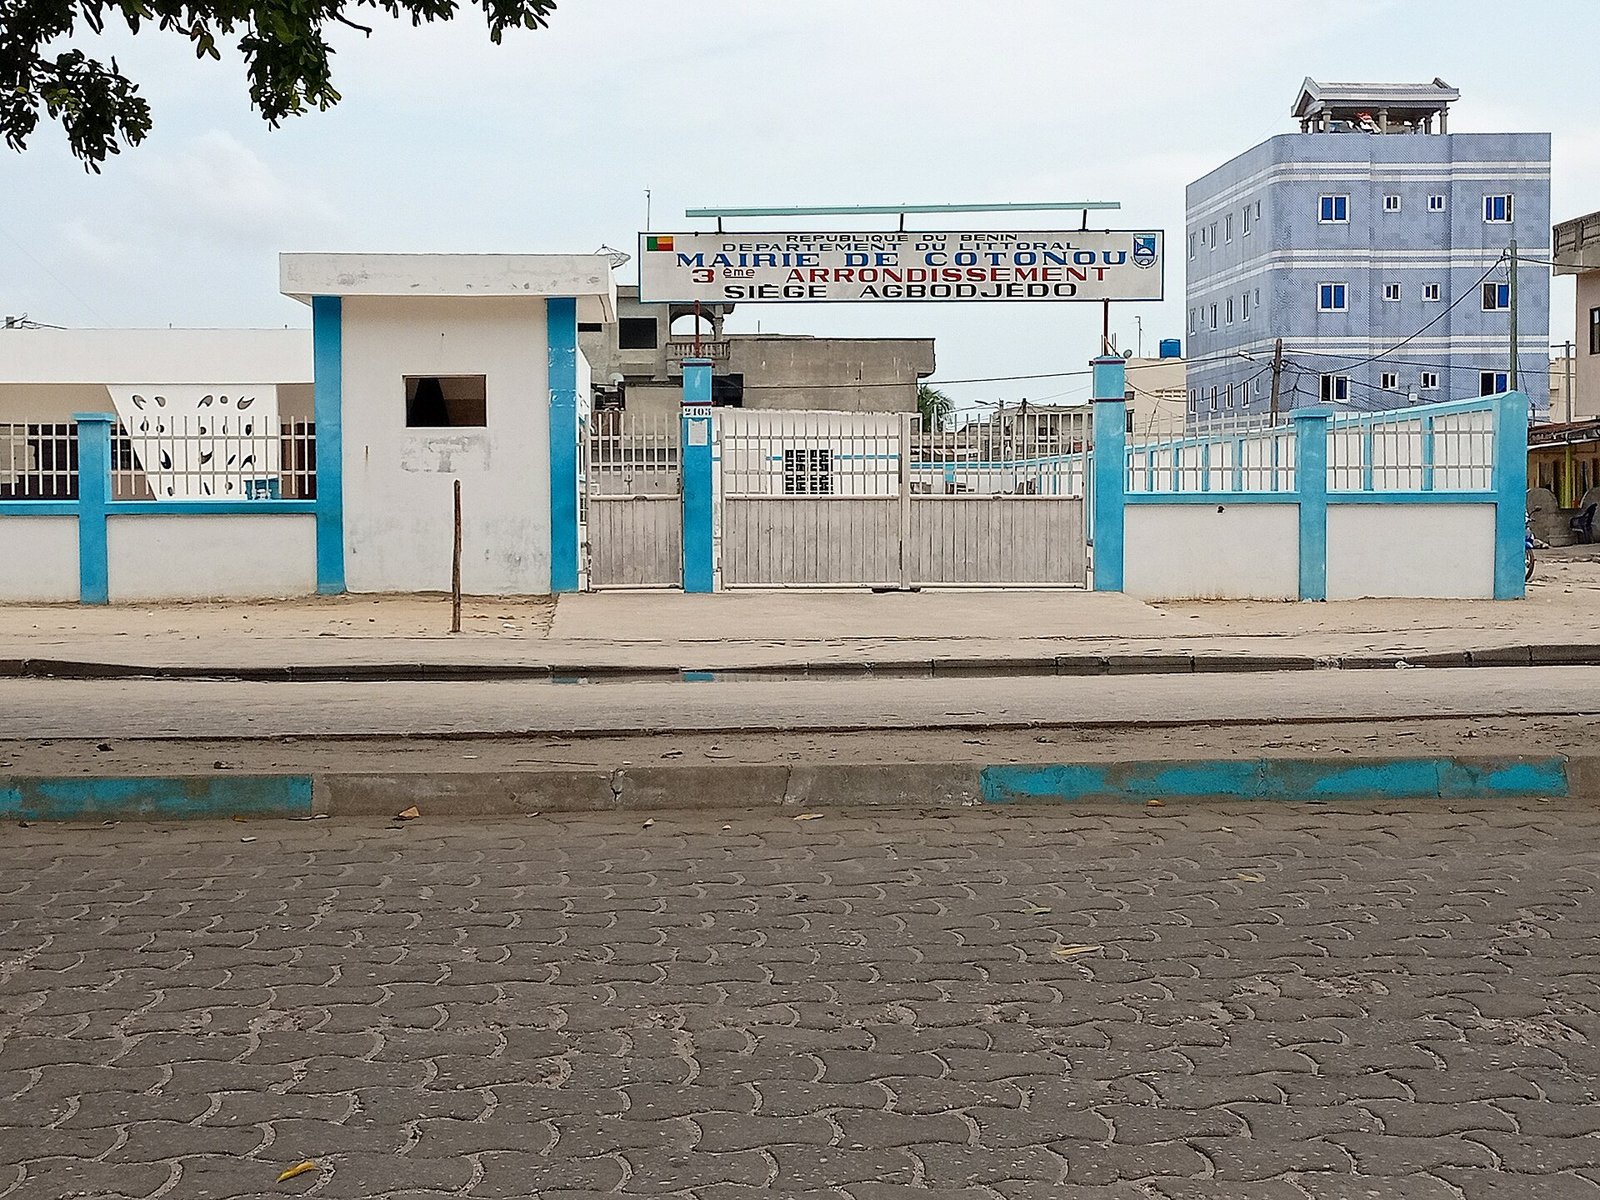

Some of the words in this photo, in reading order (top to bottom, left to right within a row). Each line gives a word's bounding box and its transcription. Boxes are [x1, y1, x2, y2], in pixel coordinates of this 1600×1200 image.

[786, 234, 908, 242] REPUBLIQUE
[722, 243, 903, 251] DEPARTEMENT
[915, 242, 945, 250] DU
[959, 242, 1080, 250] LITTORAL
[676, 253, 820, 267] MAIRIE
[845, 252, 899, 267] DE
[924, 251, 1127, 266] COTONOU
[692, 268, 715, 283] 3
[786, 267, 1111, 283] ARRONDISSEMENT
[724, 283, 827, 299] SIÈGE
